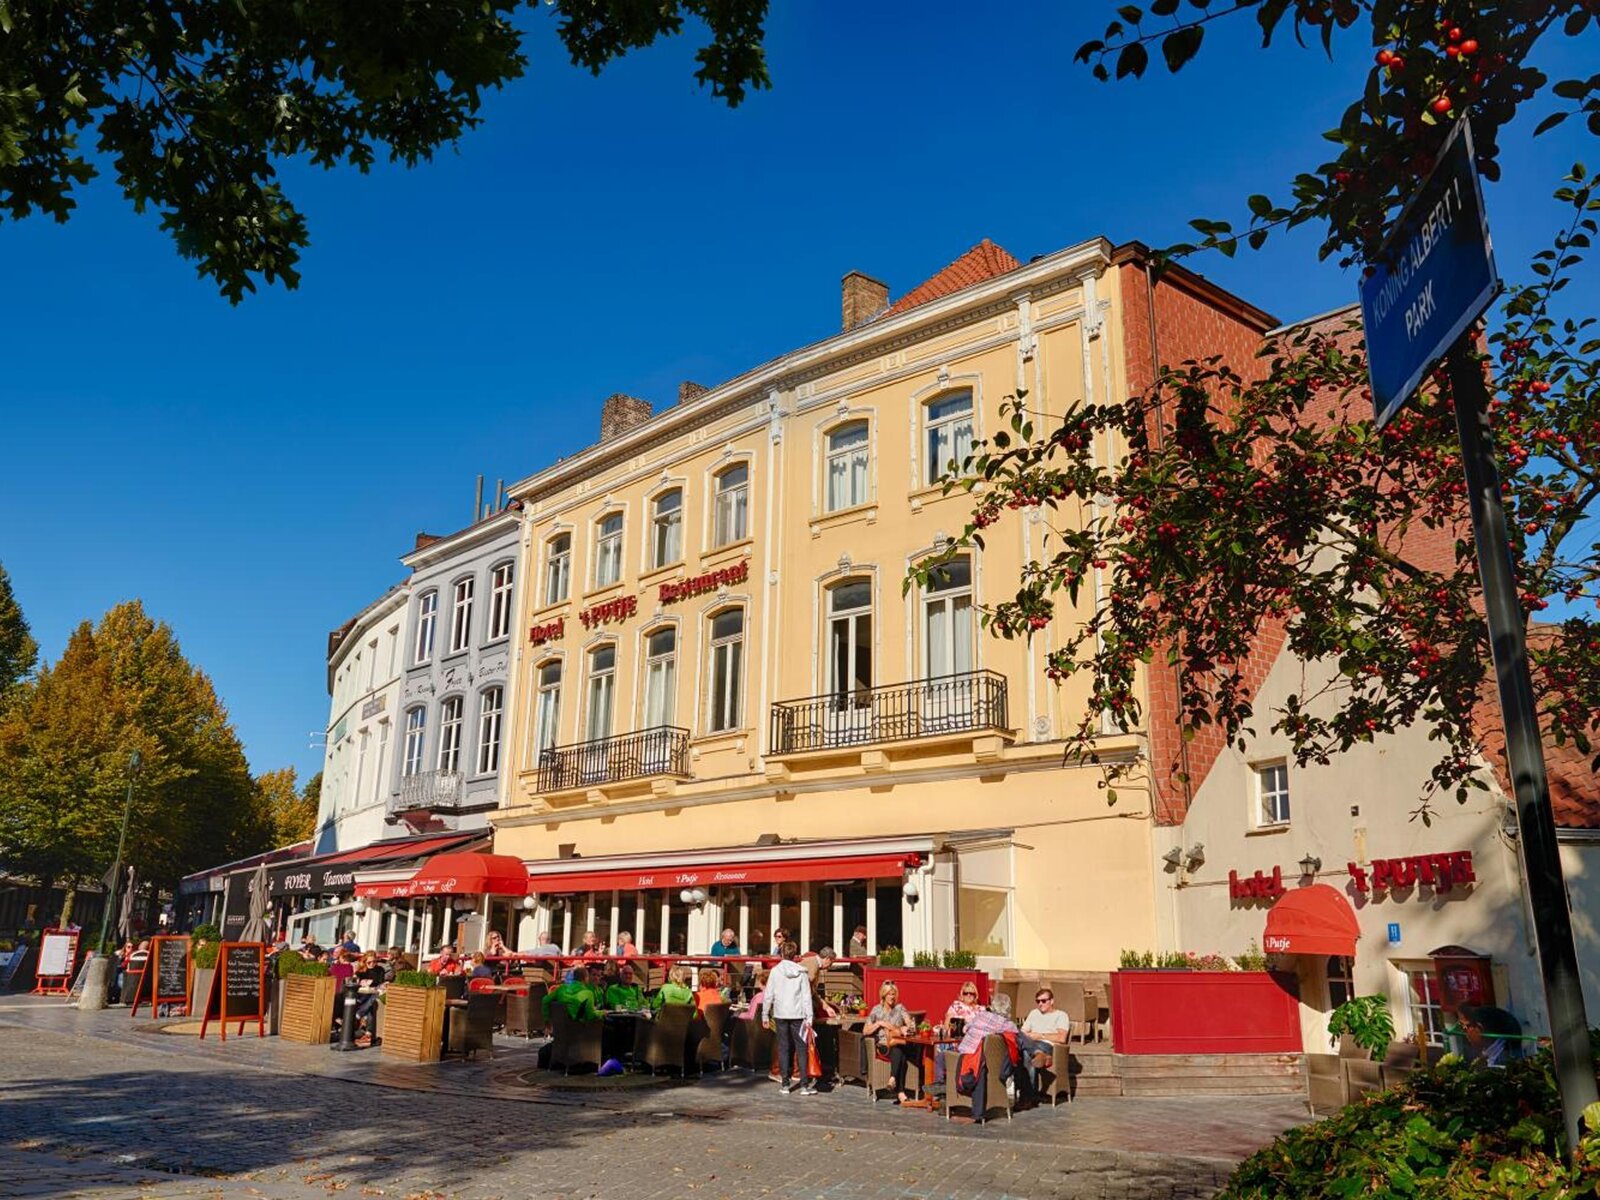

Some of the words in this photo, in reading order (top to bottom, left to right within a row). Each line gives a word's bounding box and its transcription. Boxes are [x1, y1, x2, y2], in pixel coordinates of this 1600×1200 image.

[1372, 259, 1409, 328] KONING
[1410, 186, 1453, 277] ALBERT
[1405, 279, 1437, 343] PARK
[529, 616, 565, 644] Hotel
[658, 559, 749, 603] Restaurant
[284, 872, 312, 891] FOYER
[1229, 865, 1287, 898] hotel
[1269, 935, 1291, 952] Putje
